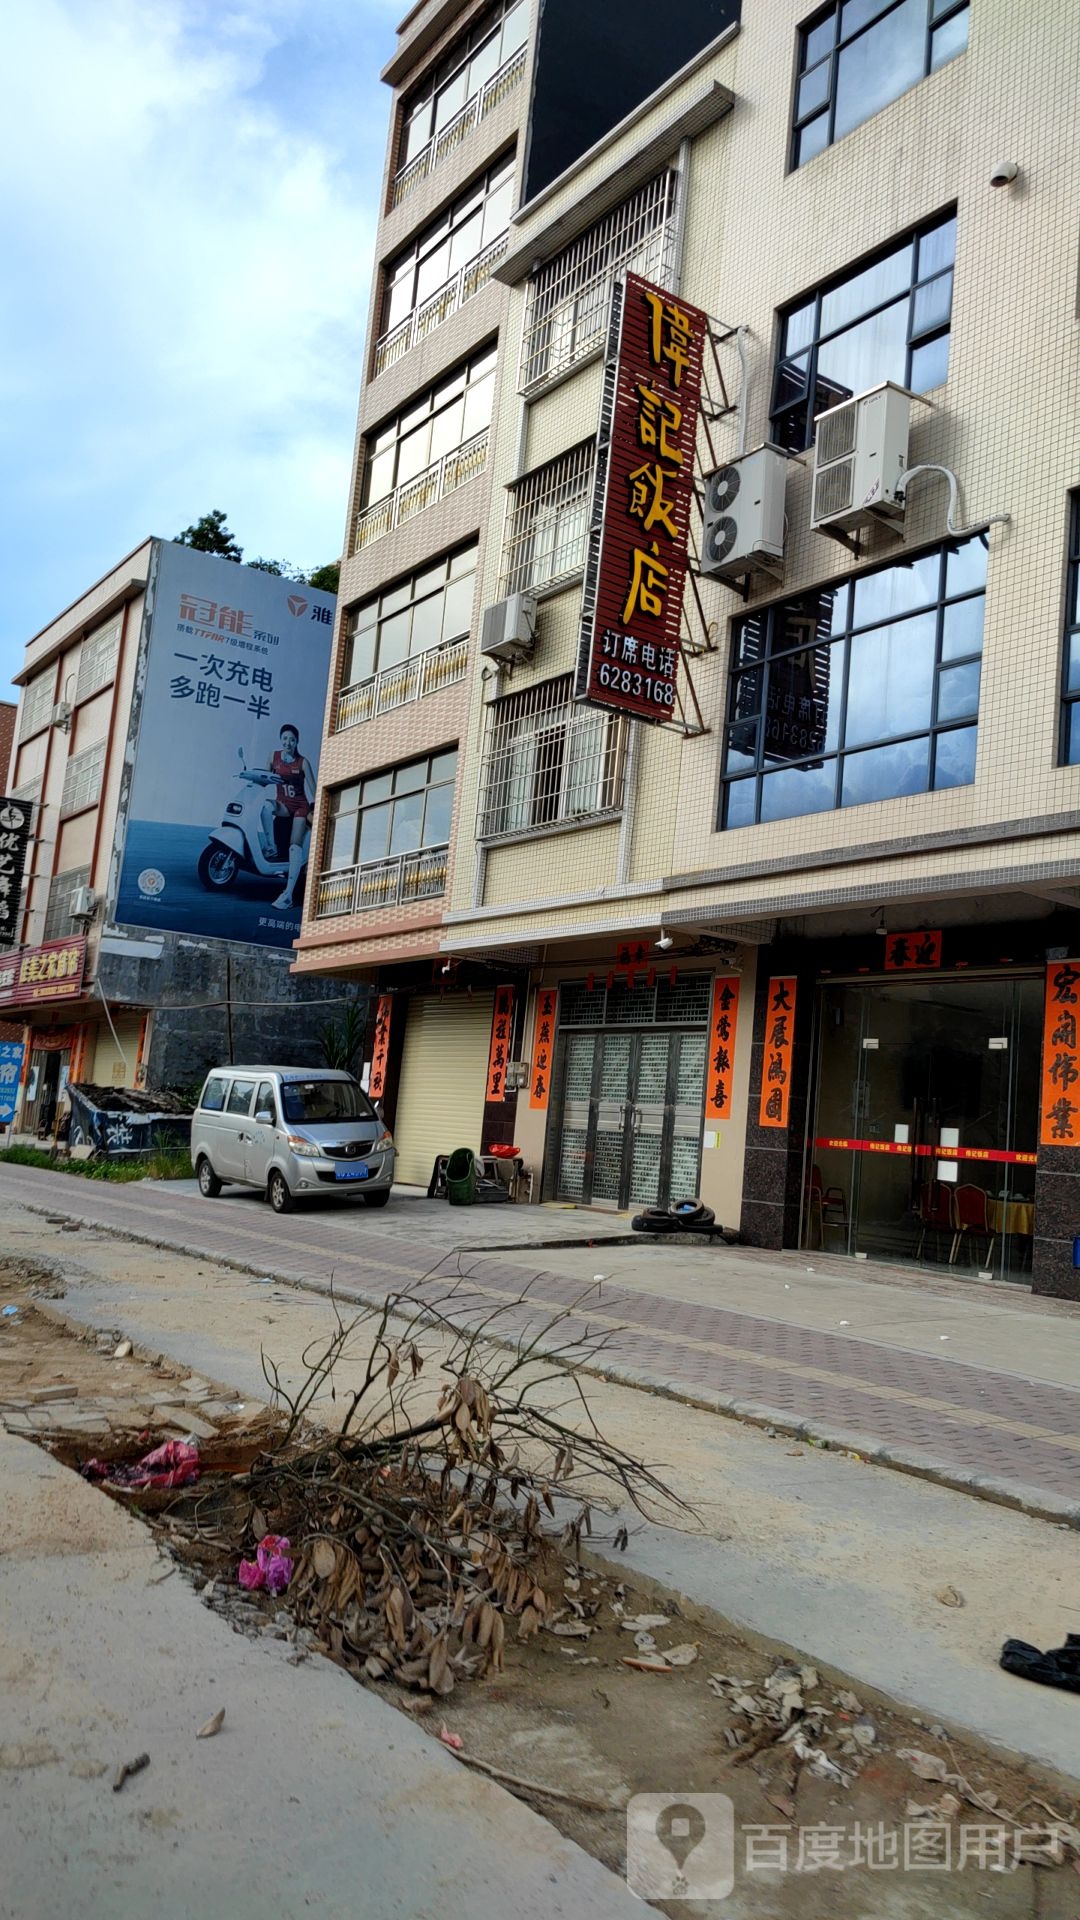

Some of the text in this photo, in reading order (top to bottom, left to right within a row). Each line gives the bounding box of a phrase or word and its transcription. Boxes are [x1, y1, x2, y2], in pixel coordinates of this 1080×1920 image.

[179, 593, 253, 638] 冠能
[311, 605, 333, 625] 雅
[174, 652, 273, 693] 一次充电
[601, 628, 676, 678] 订席电话
[170, 675, 271, 720] 多跑一半
[599, 662, 675, 707] 6283168
[282, 784, 295, 798] 16
[0, 1045, 22, 1060] 之家
